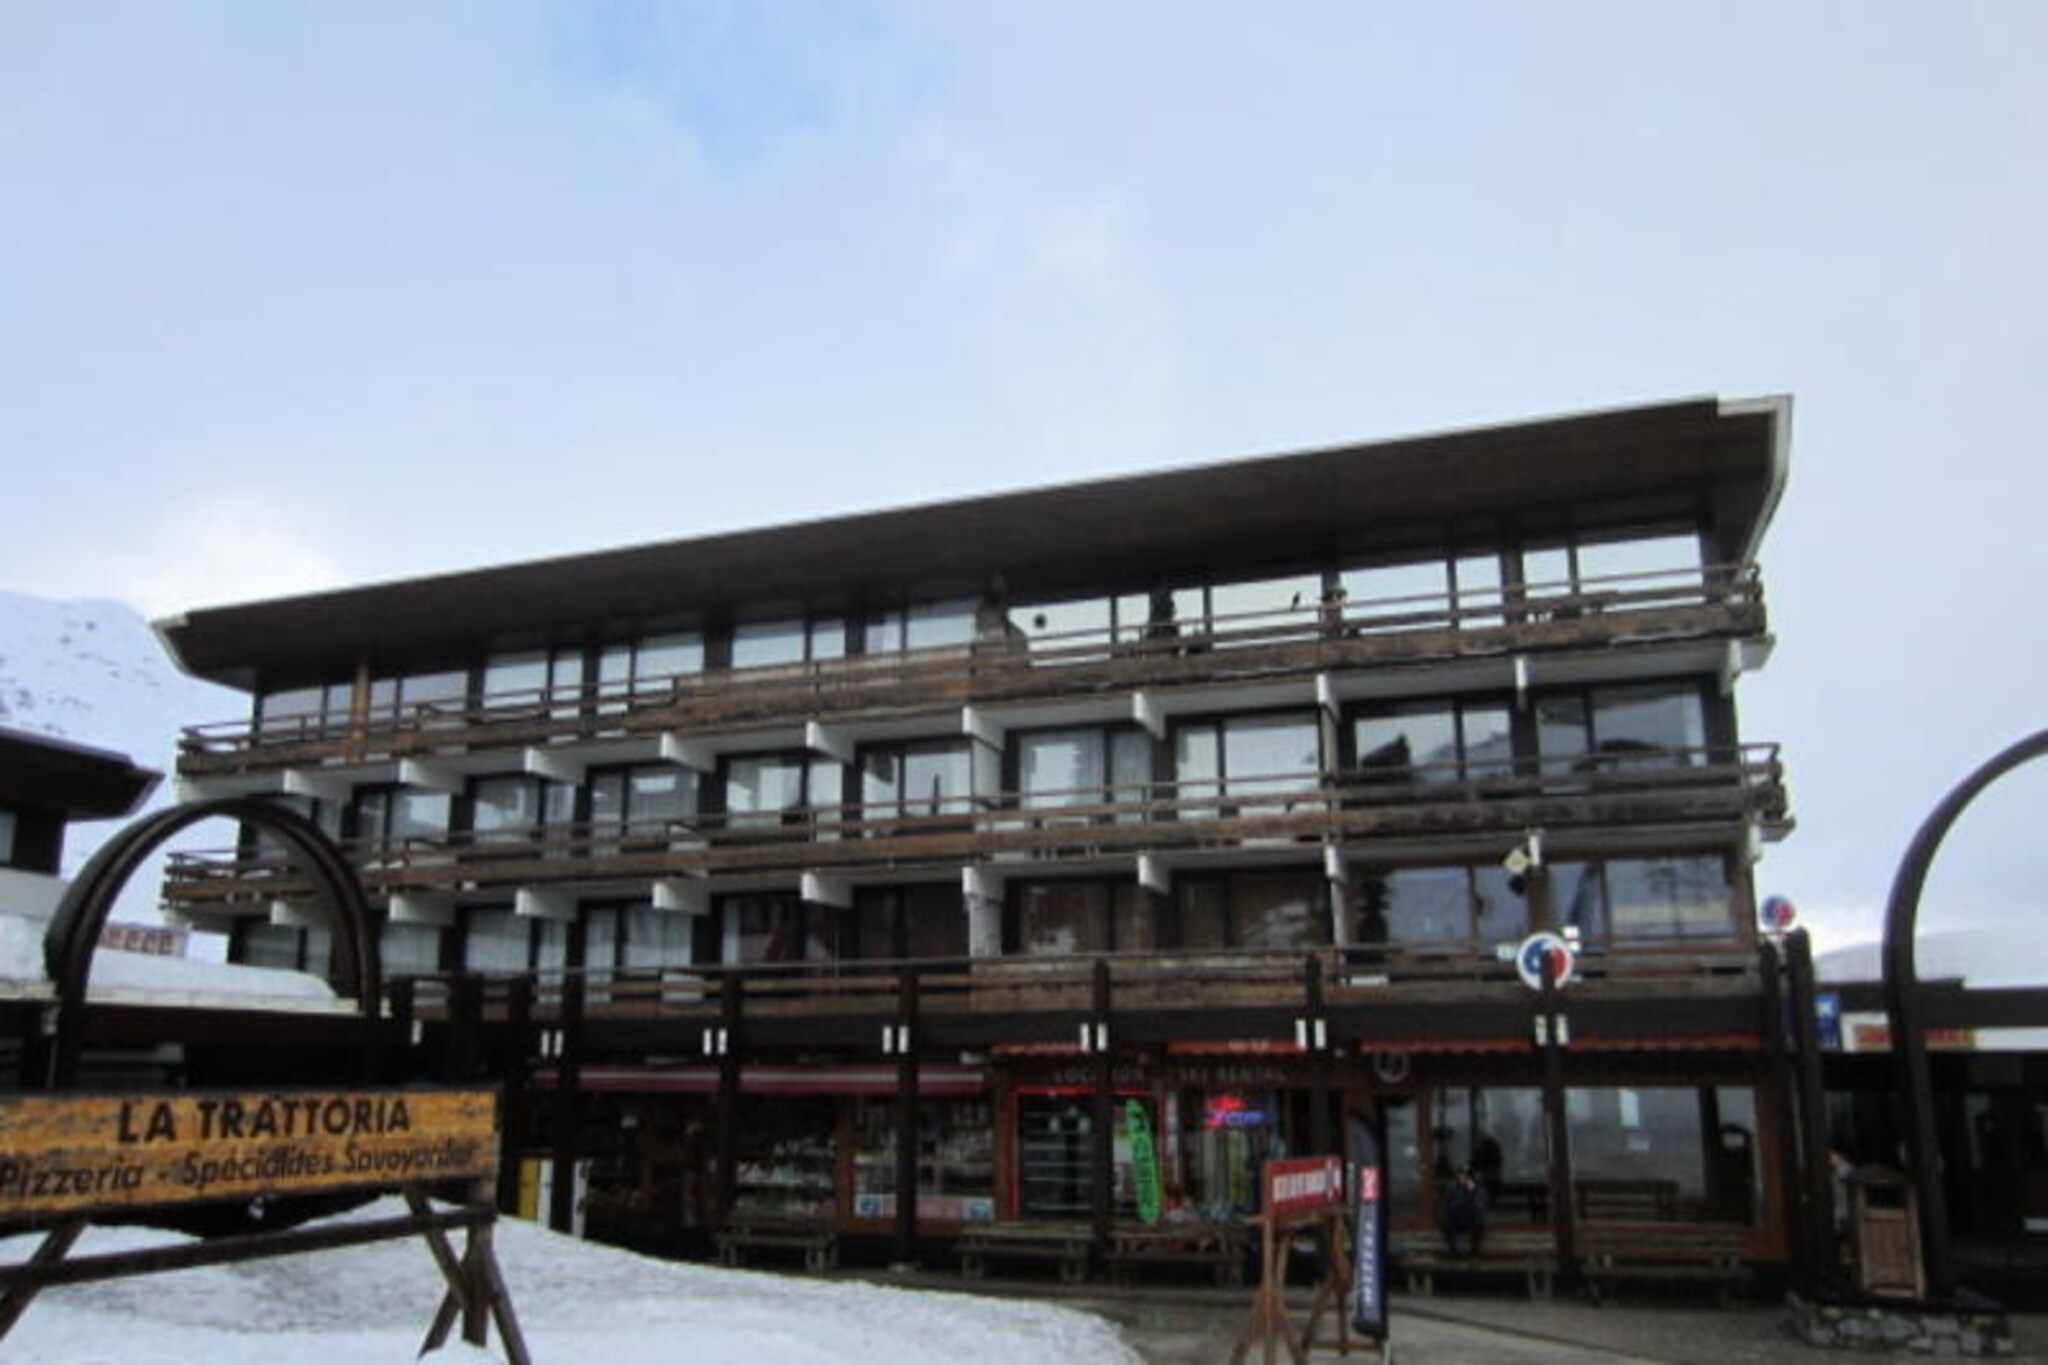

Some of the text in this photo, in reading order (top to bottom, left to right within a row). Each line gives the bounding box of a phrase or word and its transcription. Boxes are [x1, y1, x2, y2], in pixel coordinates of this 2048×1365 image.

[118, 1096, 411, 1143] LA TRATTORIA
[0, 1154, 144, 1198] Pizzeria
